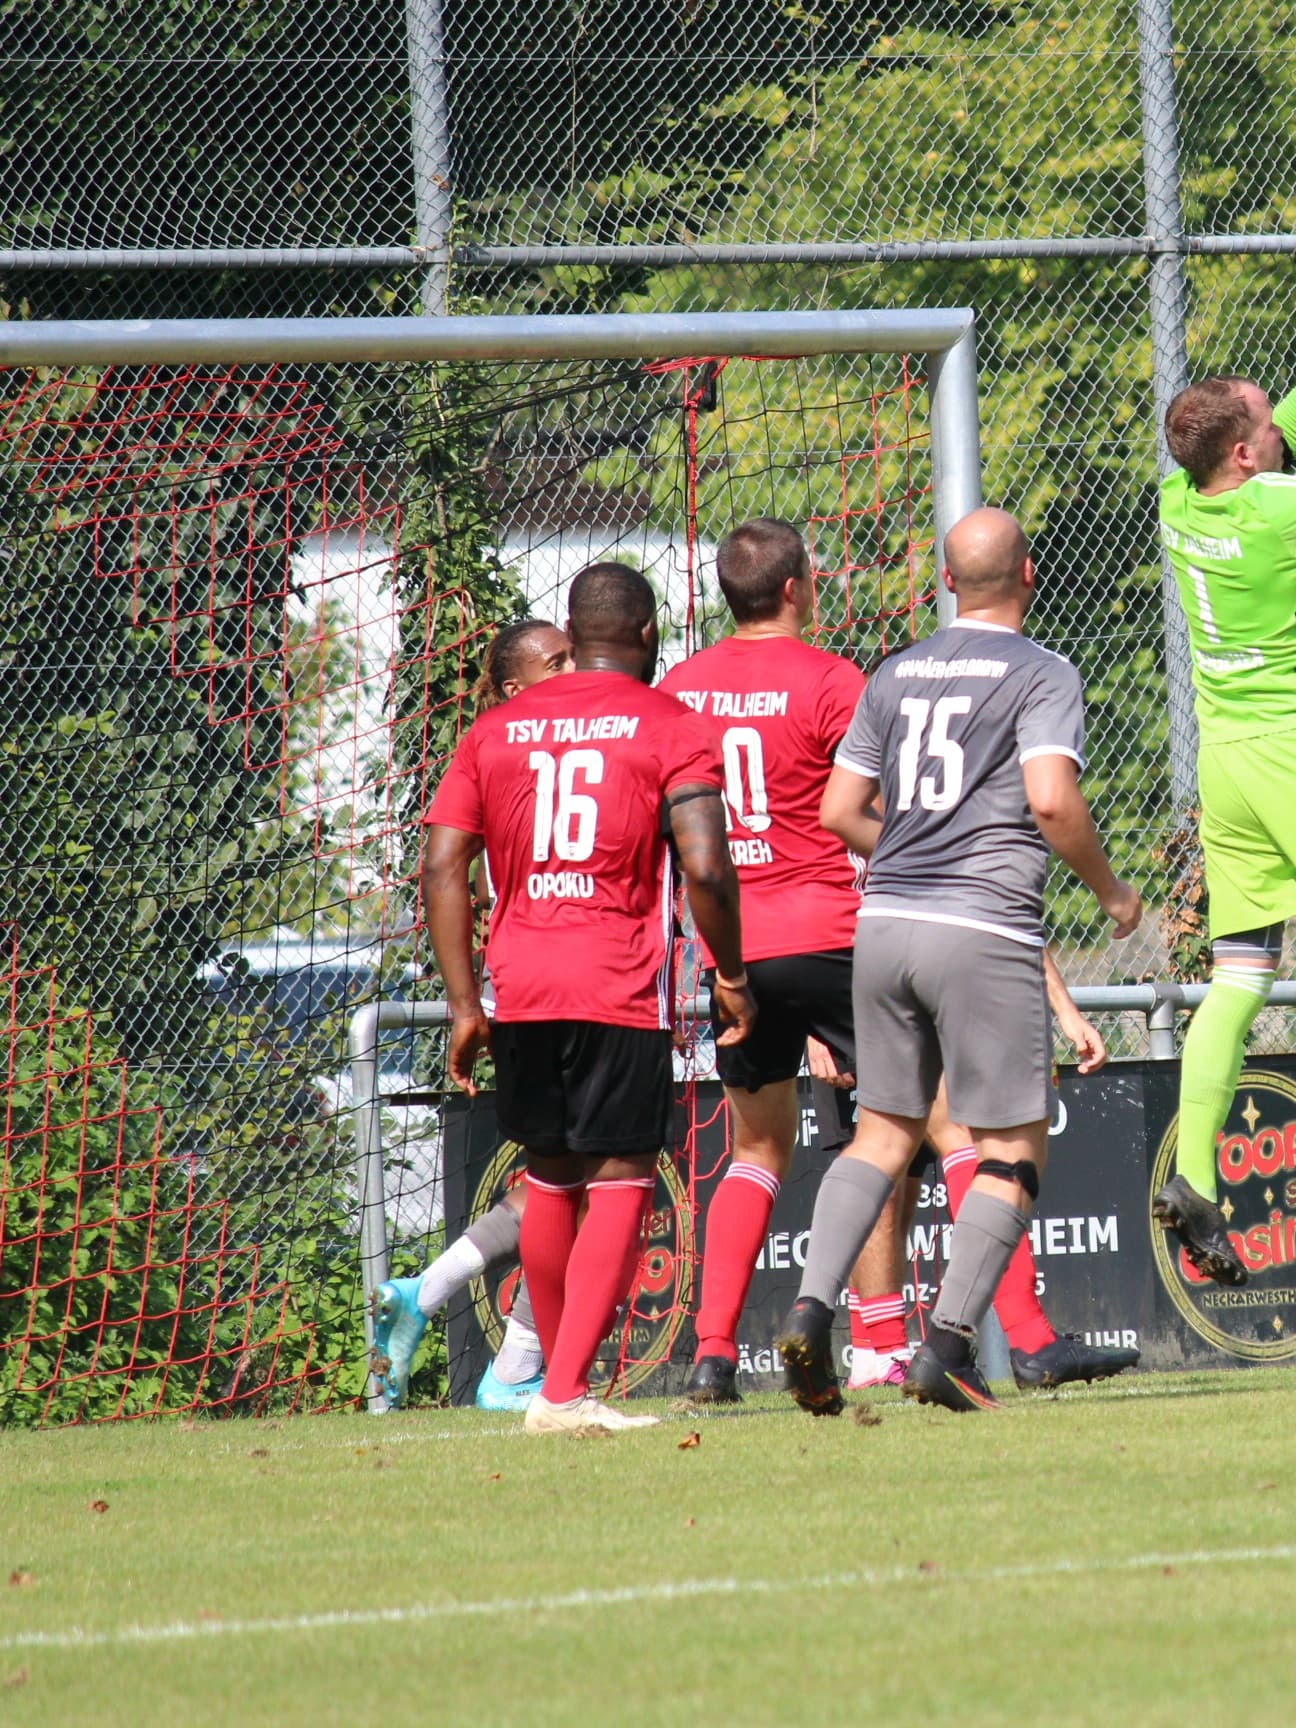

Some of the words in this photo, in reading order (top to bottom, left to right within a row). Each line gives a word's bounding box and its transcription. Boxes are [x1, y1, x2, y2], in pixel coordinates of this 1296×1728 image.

[1187, 564, 1222, 644] 1
[505, 719, 548, 744] TSV
[552, 715, 640, 744] TALHEIM
[711, 691, 789, 718] TALHEIM
[721, 726, 772, 833] 0
[897, 696, 972, 812] 15
[529, 749, 604, 862] 16
[528, 871, 595, 900] OPOKU
